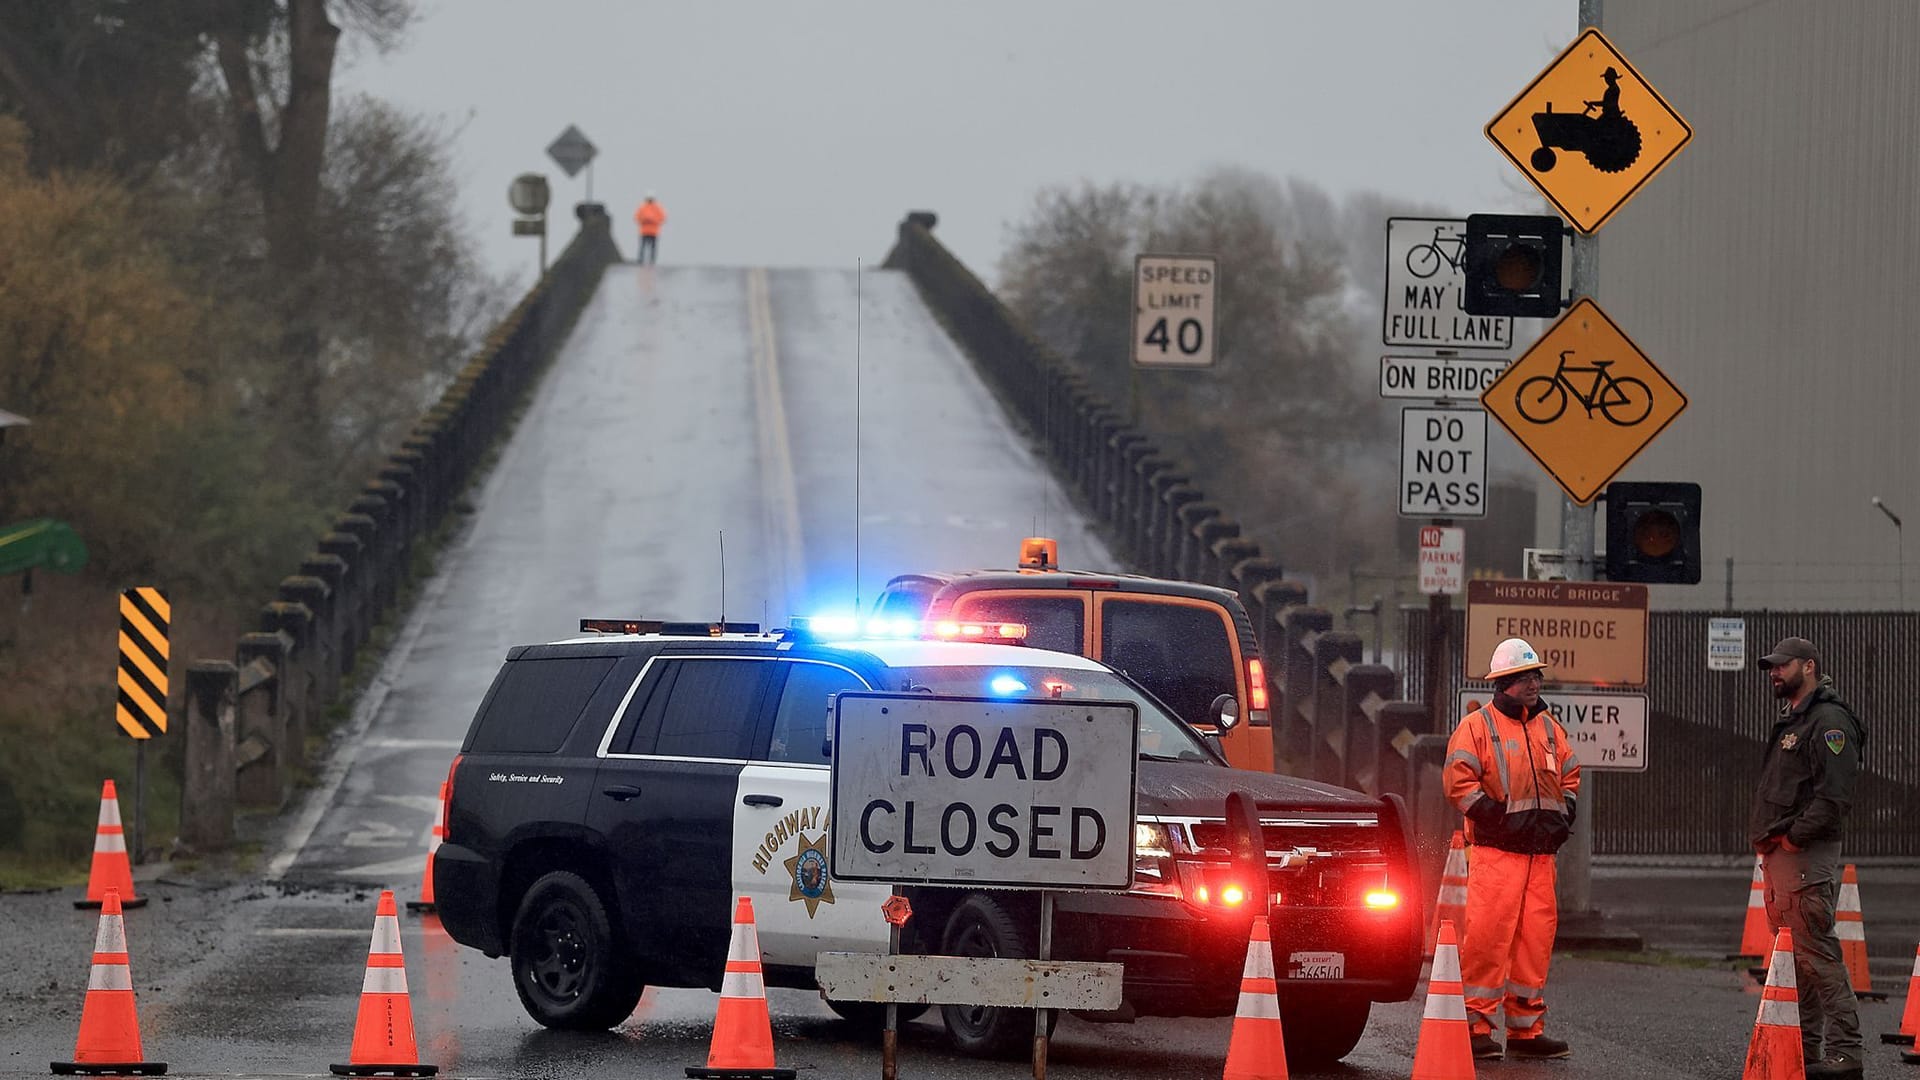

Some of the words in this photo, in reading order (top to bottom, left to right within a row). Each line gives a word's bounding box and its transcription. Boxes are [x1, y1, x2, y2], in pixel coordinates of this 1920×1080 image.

[1143, 266, 1211, 284] SPEED
[1148, 293, 1202, 310] LIMIT
[1405, 285, 1445, 310] MAY
[1144, 317, 1203, 355] 40
[1392, 314, 1441, 339] FULL
[1453, 316, 1504, 342] LANE
[1386, 365, 1415, 389] ON
[1427, 418, 1463, 442] DO
[1417, 450, 1472, 474] NOT
[1408, 482, 1479, 506] PASS
[1423, 530, 1439, 545] NO
[1423, 551, 1462, 564] PARKING
[1424, 576, 1457, 587] BRIDGE
[1435, 567, 1447, 576] ON
[1495, 586, 1560, 599] HISTORIC
[1568, 588, 1620, 601] BRIDGE
[1496, 617, 1617, 640] FERNBRIDGE
[1544, 649, 1575, 669] 1911
[1551, 704, 1619, 724] RIVER
[1569, 731, 1597, 742] -134
[900, 724, 1069, 781] ROAD
[1601, 749, 1616, 761] 78
[1622, 743, 1638, 756] 56
[488, 772, 507, 783] Safety,
[508, 774, 528, 783] Service
[528, 774, 541, 783] and
[540, 774, 564, 785] Security
[860, 799, 1106, 860] CLOSED
[752, 806, 821, 875] HIGHWAY
